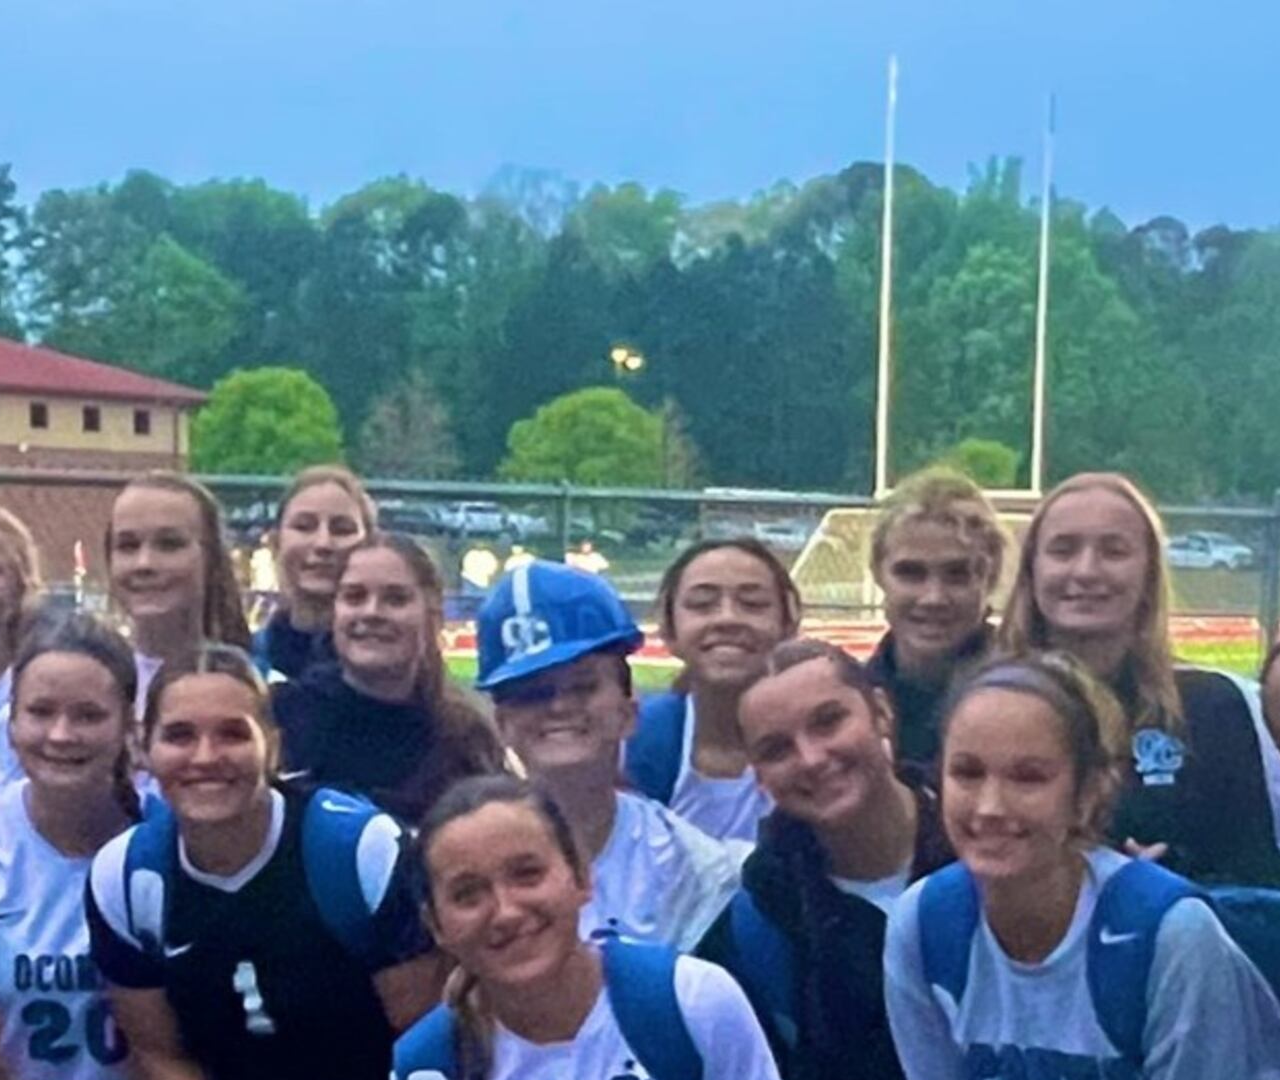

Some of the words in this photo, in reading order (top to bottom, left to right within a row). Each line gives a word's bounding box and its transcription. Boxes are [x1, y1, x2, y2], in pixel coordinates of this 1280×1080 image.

[13, 953, 99, 993] OCON
[233, 960, 276, 1034] 1
[21, 999, 129, 1065] 20
